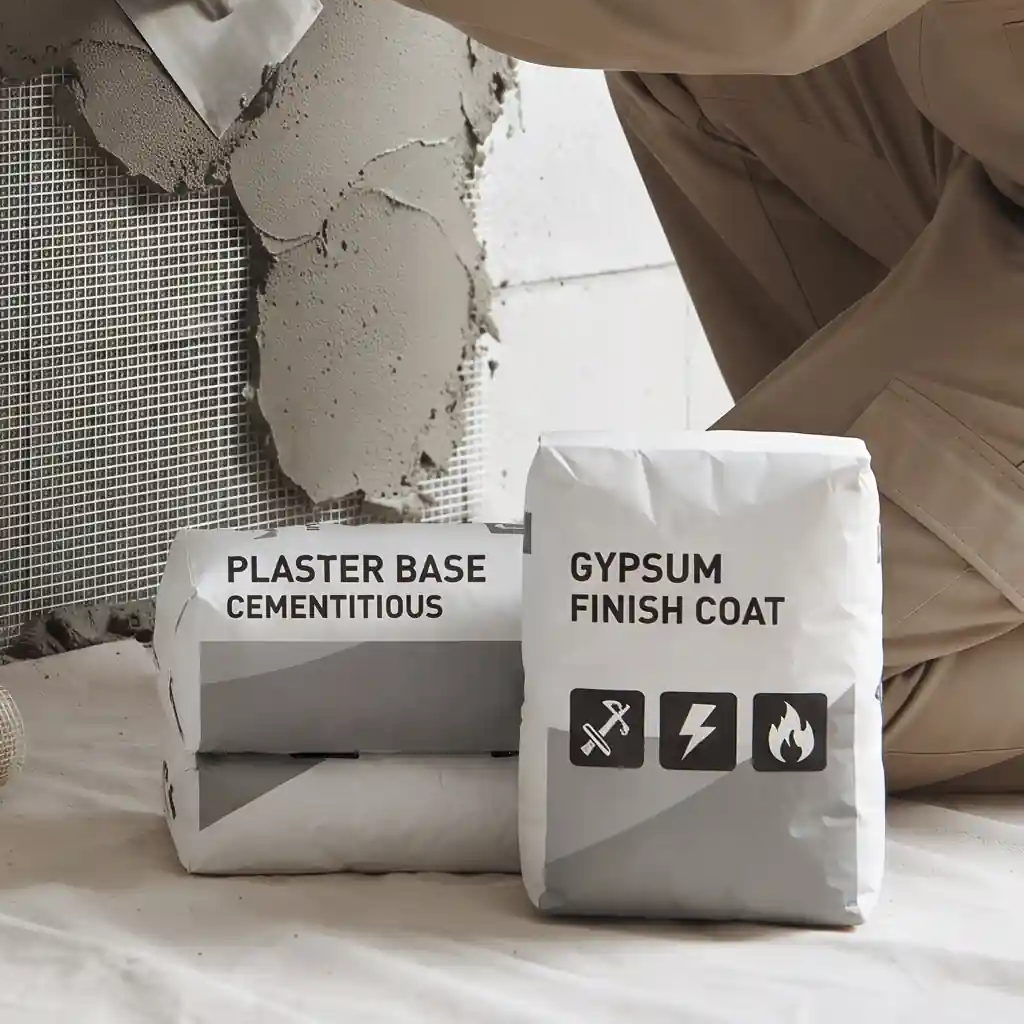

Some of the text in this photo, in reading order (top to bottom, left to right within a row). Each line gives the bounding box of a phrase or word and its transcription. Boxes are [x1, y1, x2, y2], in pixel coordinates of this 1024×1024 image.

[227, 554, 486, 583] PLASTER BASE
[570, 551, 722, 584] GYPSUM
[226, 594, 443, 619] CEMENTITIOUS
[571, 593, 785, 626] FINISH COAT
